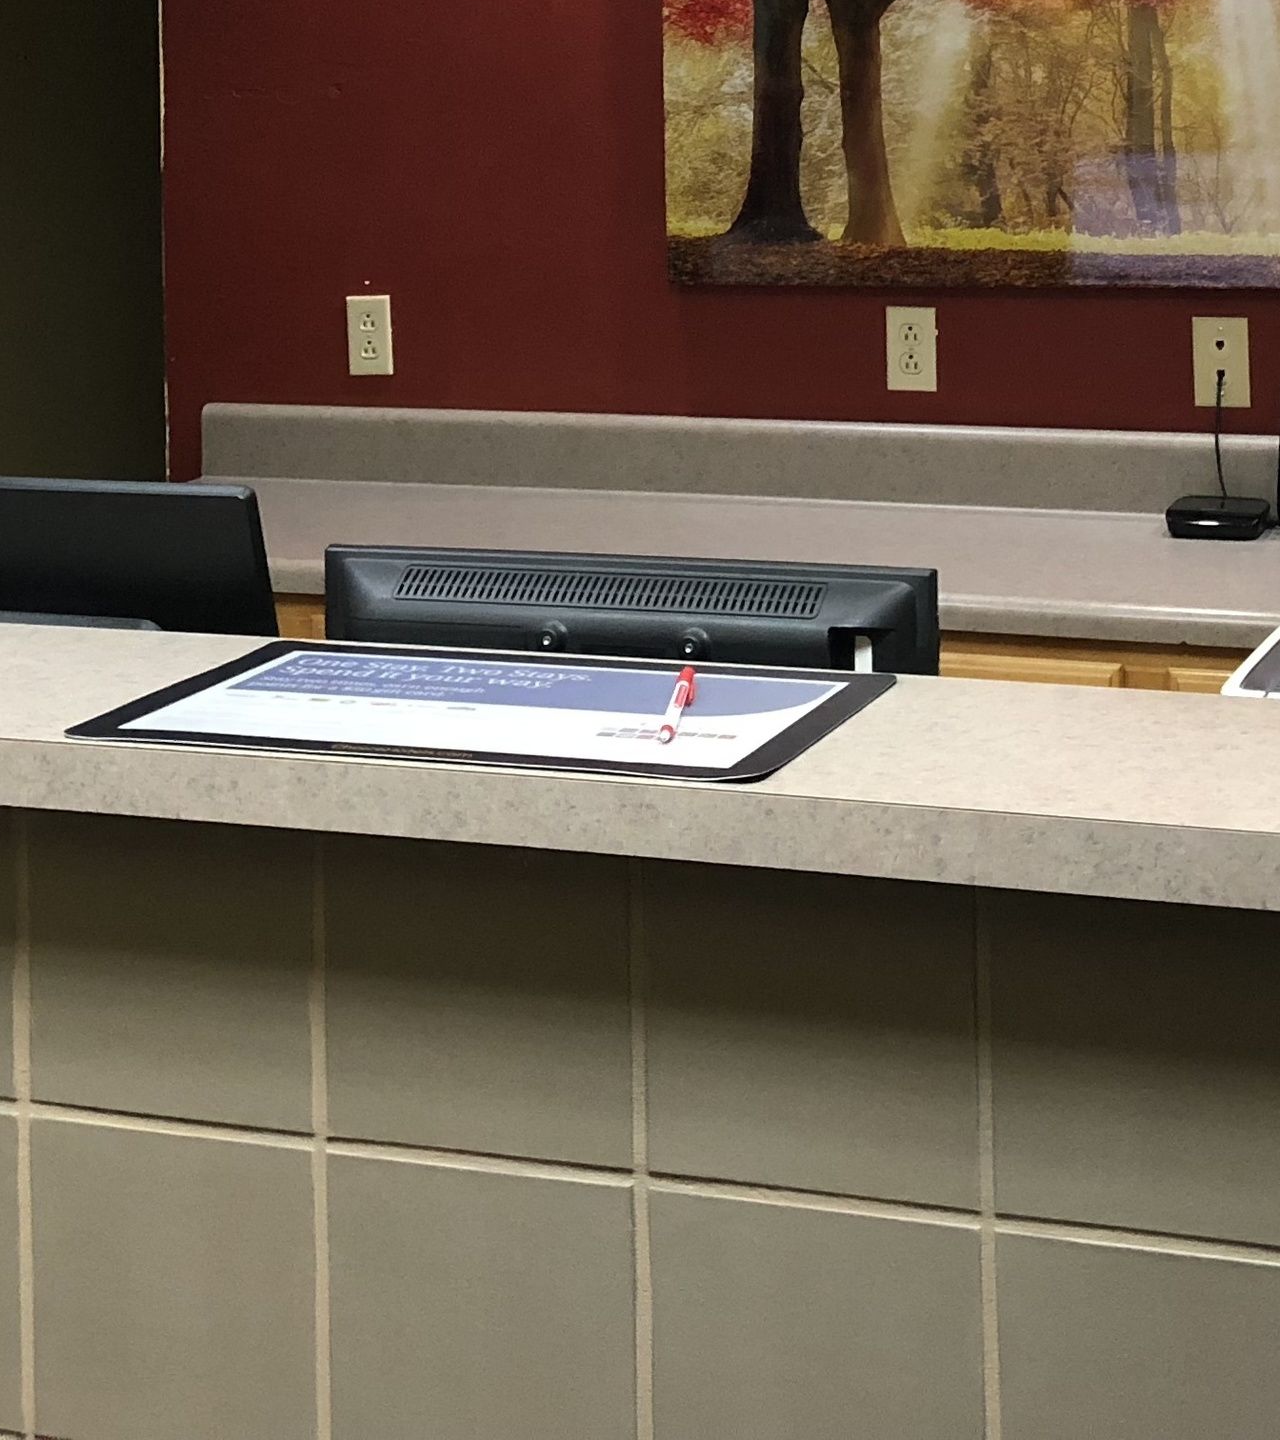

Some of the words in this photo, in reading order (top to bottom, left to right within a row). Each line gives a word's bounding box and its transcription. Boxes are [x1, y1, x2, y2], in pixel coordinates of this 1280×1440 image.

[280, 665, 375, 677] Spend
[380, 671, 402, 679] it
[405, 673, 480, 684] your
[298, 658, 359, 667] One
[441, 665, 503, 675] Two
[507, 669, 592, 682] Stays.
